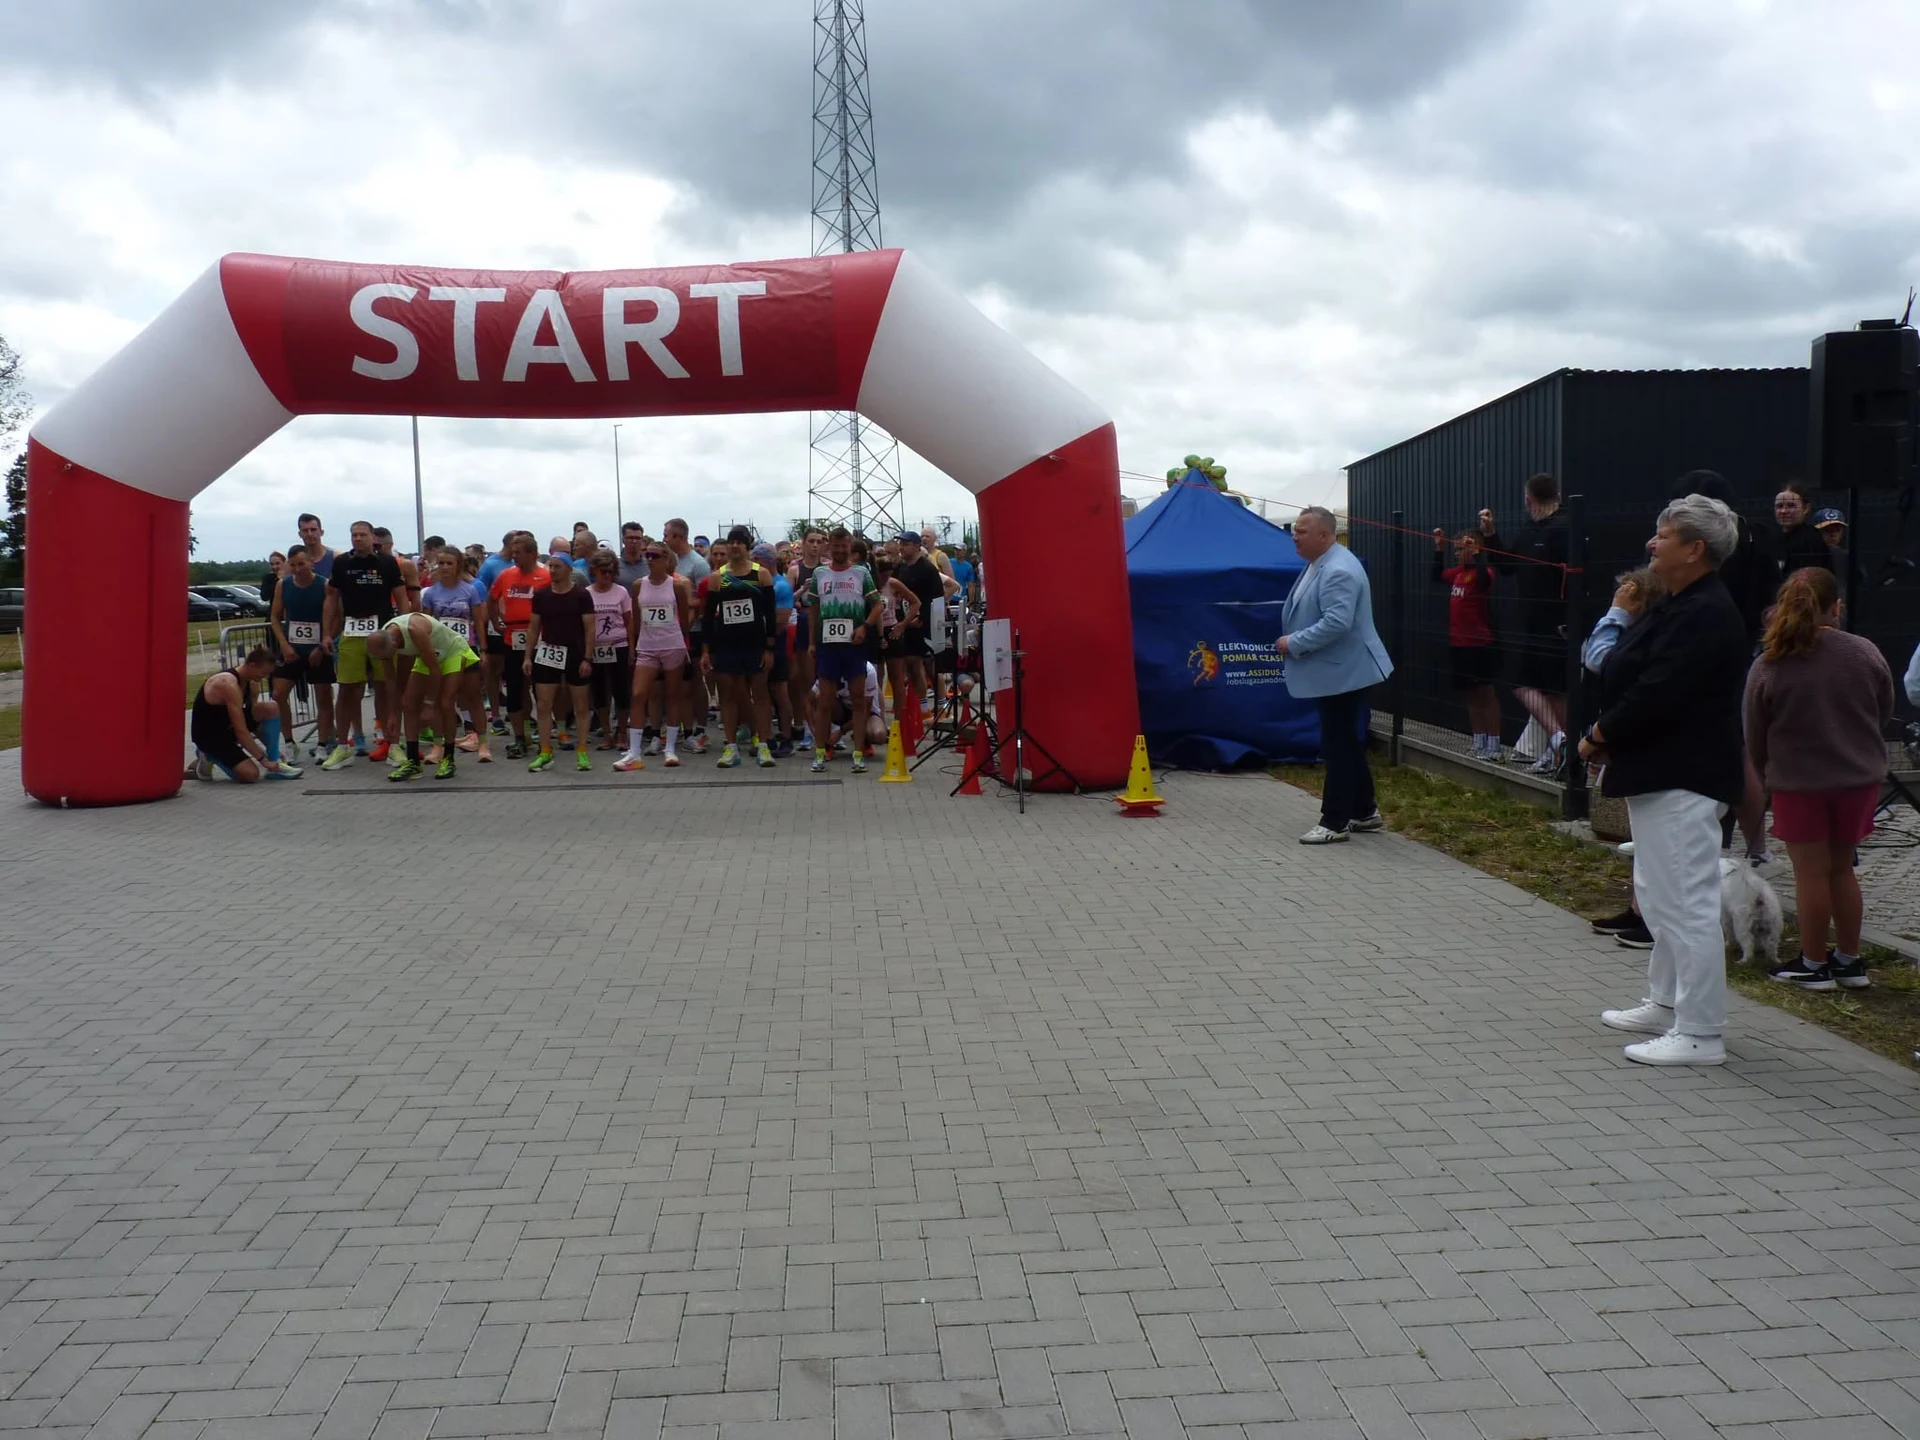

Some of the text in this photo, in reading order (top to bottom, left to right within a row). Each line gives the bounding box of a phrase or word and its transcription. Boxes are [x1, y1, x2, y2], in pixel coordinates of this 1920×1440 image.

[348, 280, 766, 383] START
[648, 609, 666, 621] 78
[726, 604, 751, 618] 136
[349, 620, 375, 631] 158
[829, 623, 846, 636] 80
[295, 626, 313, 639] 63
[541, 647, 565, 662] 133
[1222, 653, 1258, 663] POMIAR
